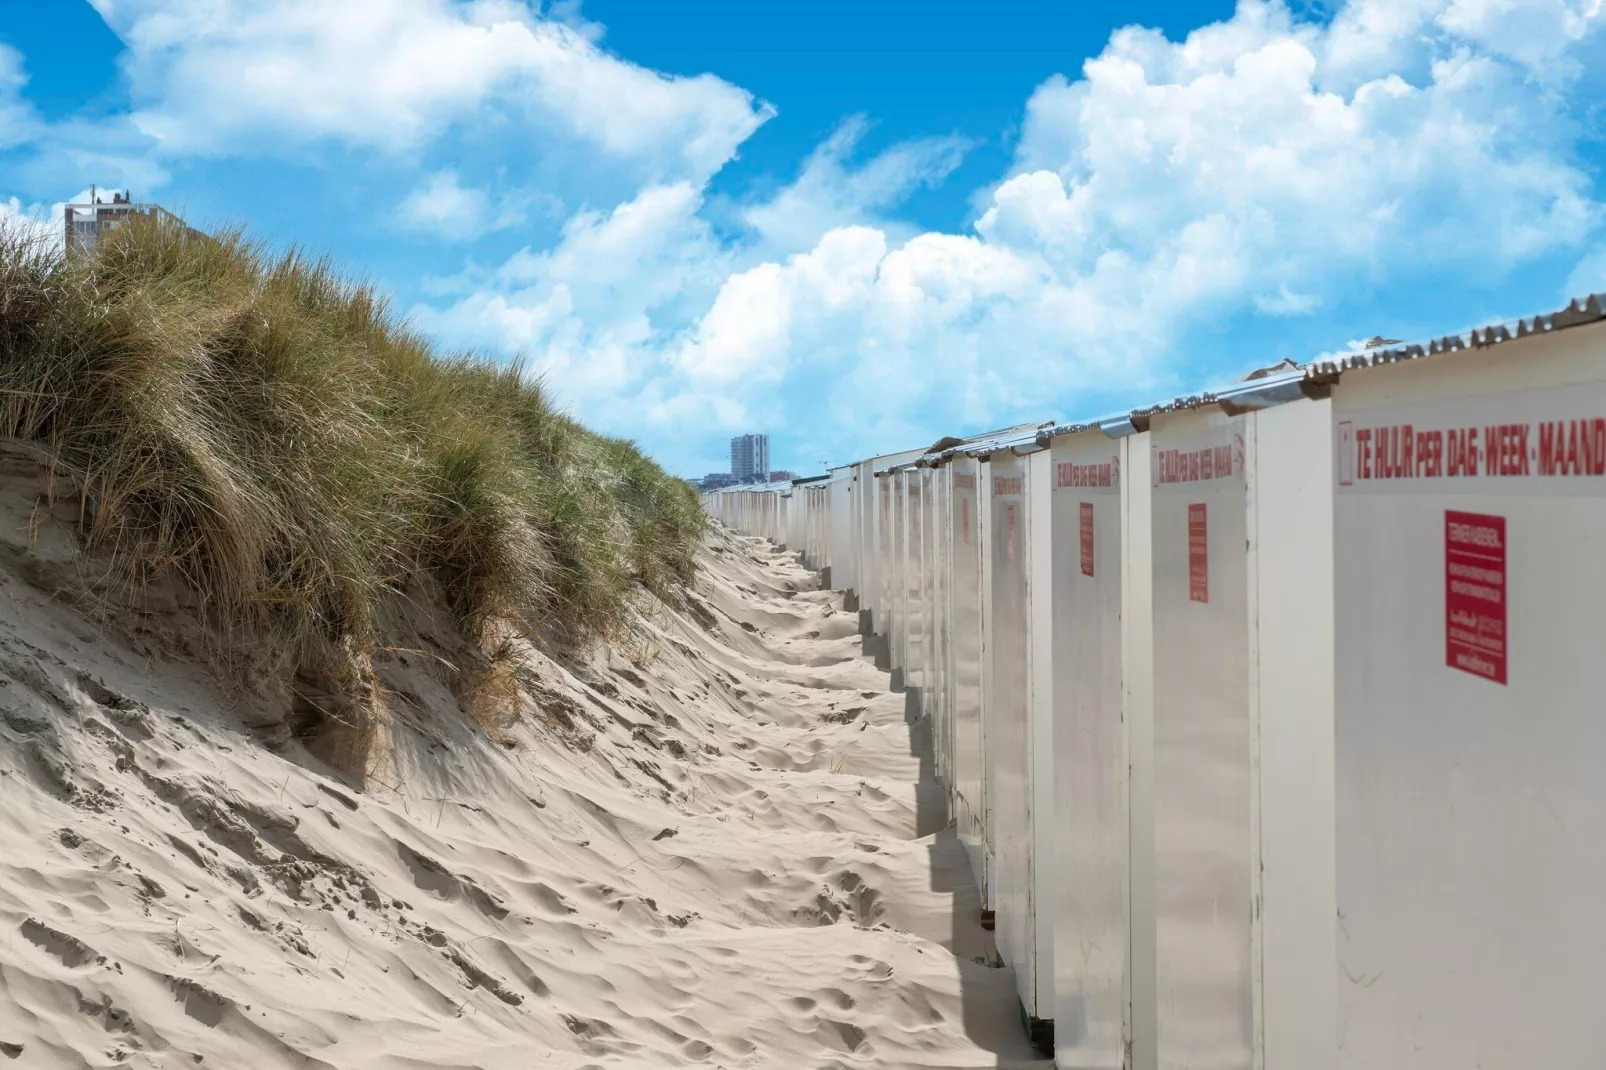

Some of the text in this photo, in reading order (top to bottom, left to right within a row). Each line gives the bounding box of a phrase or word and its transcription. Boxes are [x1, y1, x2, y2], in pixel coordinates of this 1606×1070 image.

[1356, 417, 1606, 479] TE HUUR PER DAG WEEK MAAND
